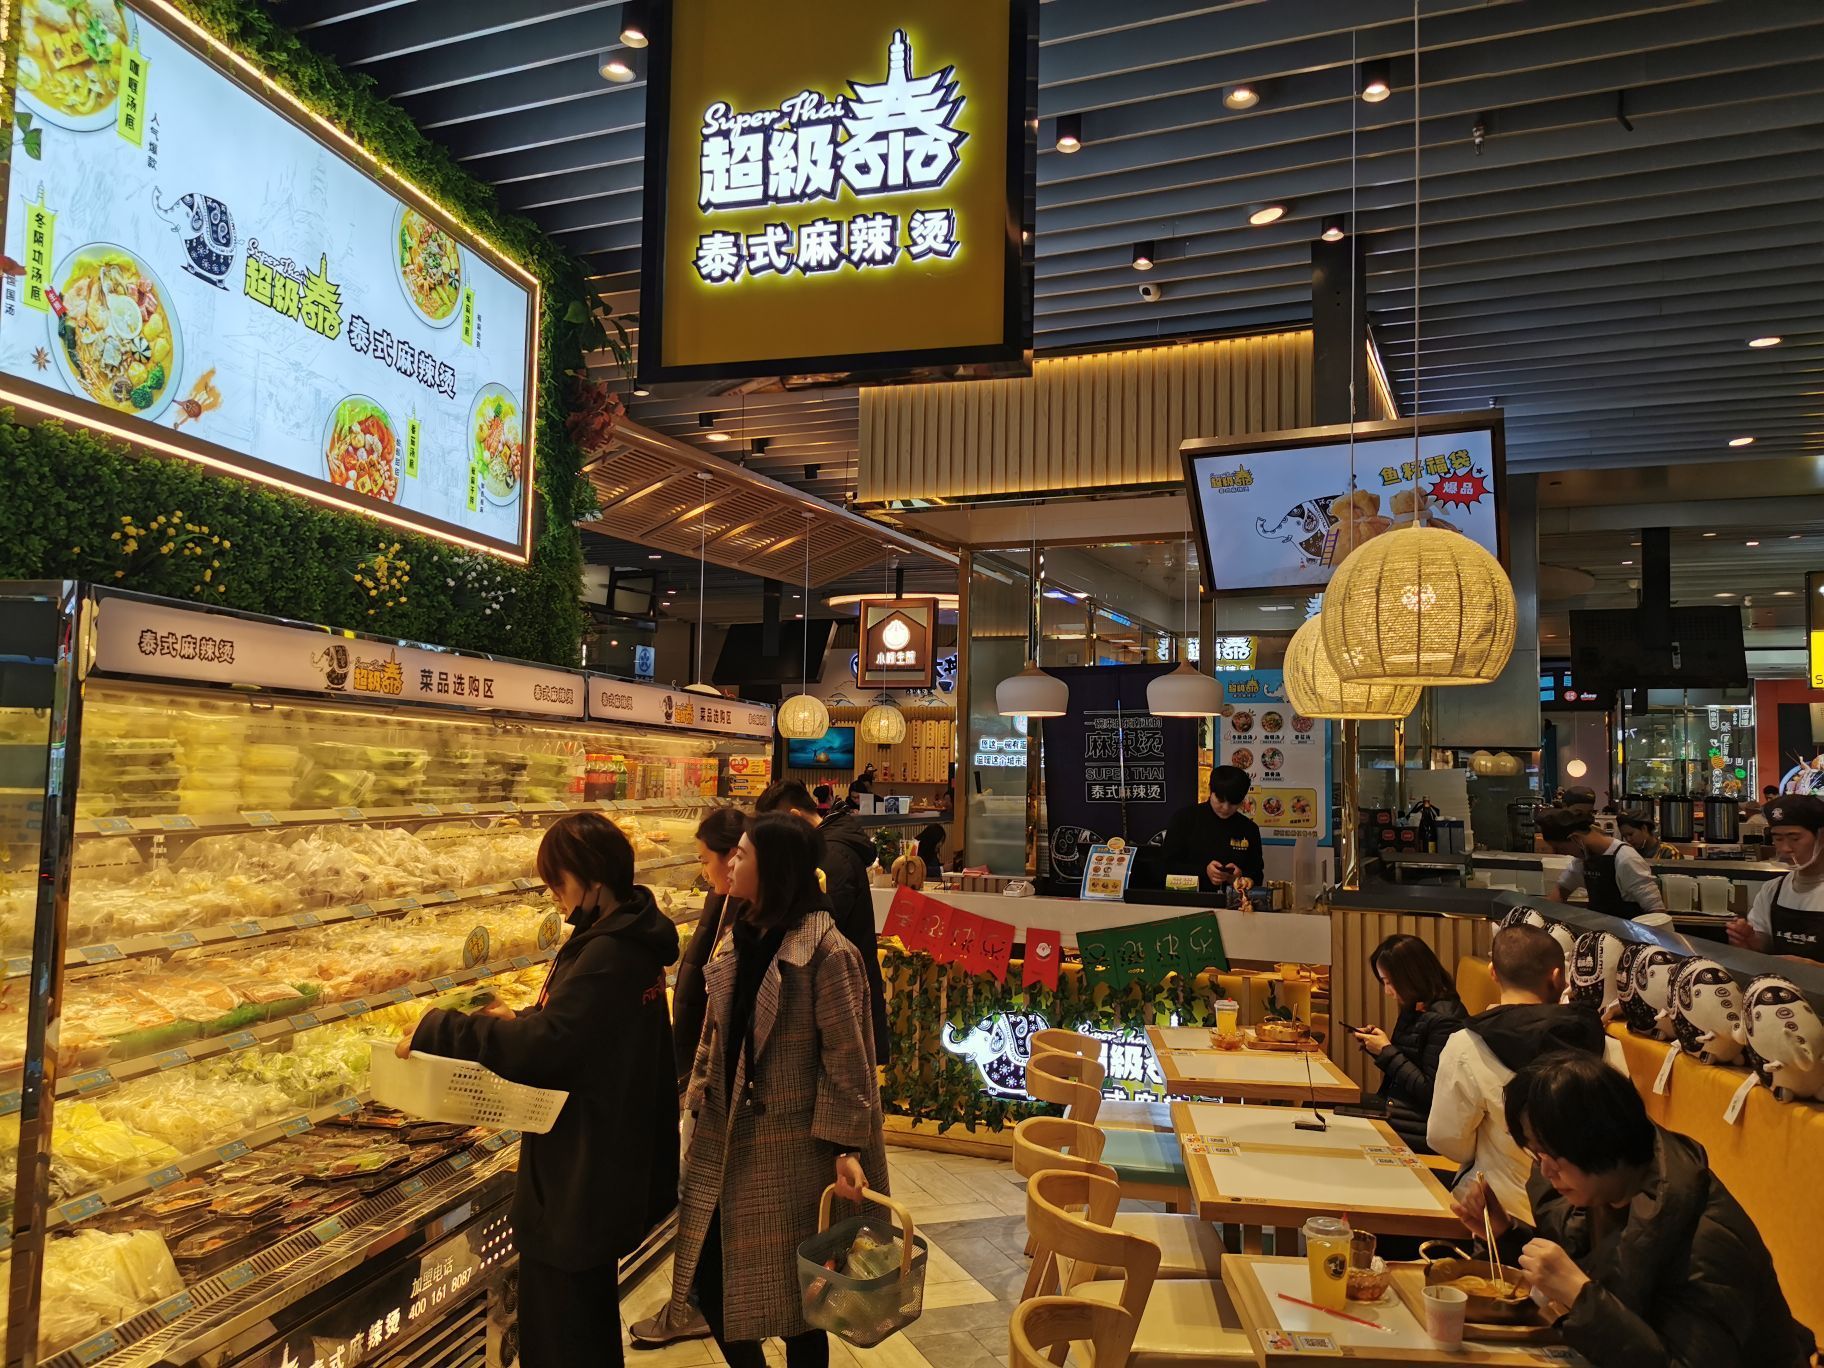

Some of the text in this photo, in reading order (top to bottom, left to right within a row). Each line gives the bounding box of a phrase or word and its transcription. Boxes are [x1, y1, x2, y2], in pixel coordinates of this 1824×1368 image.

[701, 88, 846, 141] Super Thai
[692, 207, 961, 284] 泰式麻辣烫
[347, 313, 456, 399] 泰式麻辣烫
[1442, 481, 1475, 496] 爆品
[138, 629, 235, 665] 泰式麻辣烫
[419, 668, 495, 699] 菜品选购区
[1085, 730, 1165, 759] 麻辣烫
[1091, 784, 1160, 799] 泰式麻辣烫
[1131, 767, 1165, 780] THAI
[408, 1267, 473, 1320] 400 161 8087
[410, 1256, 455, 1299] 加盟电话
